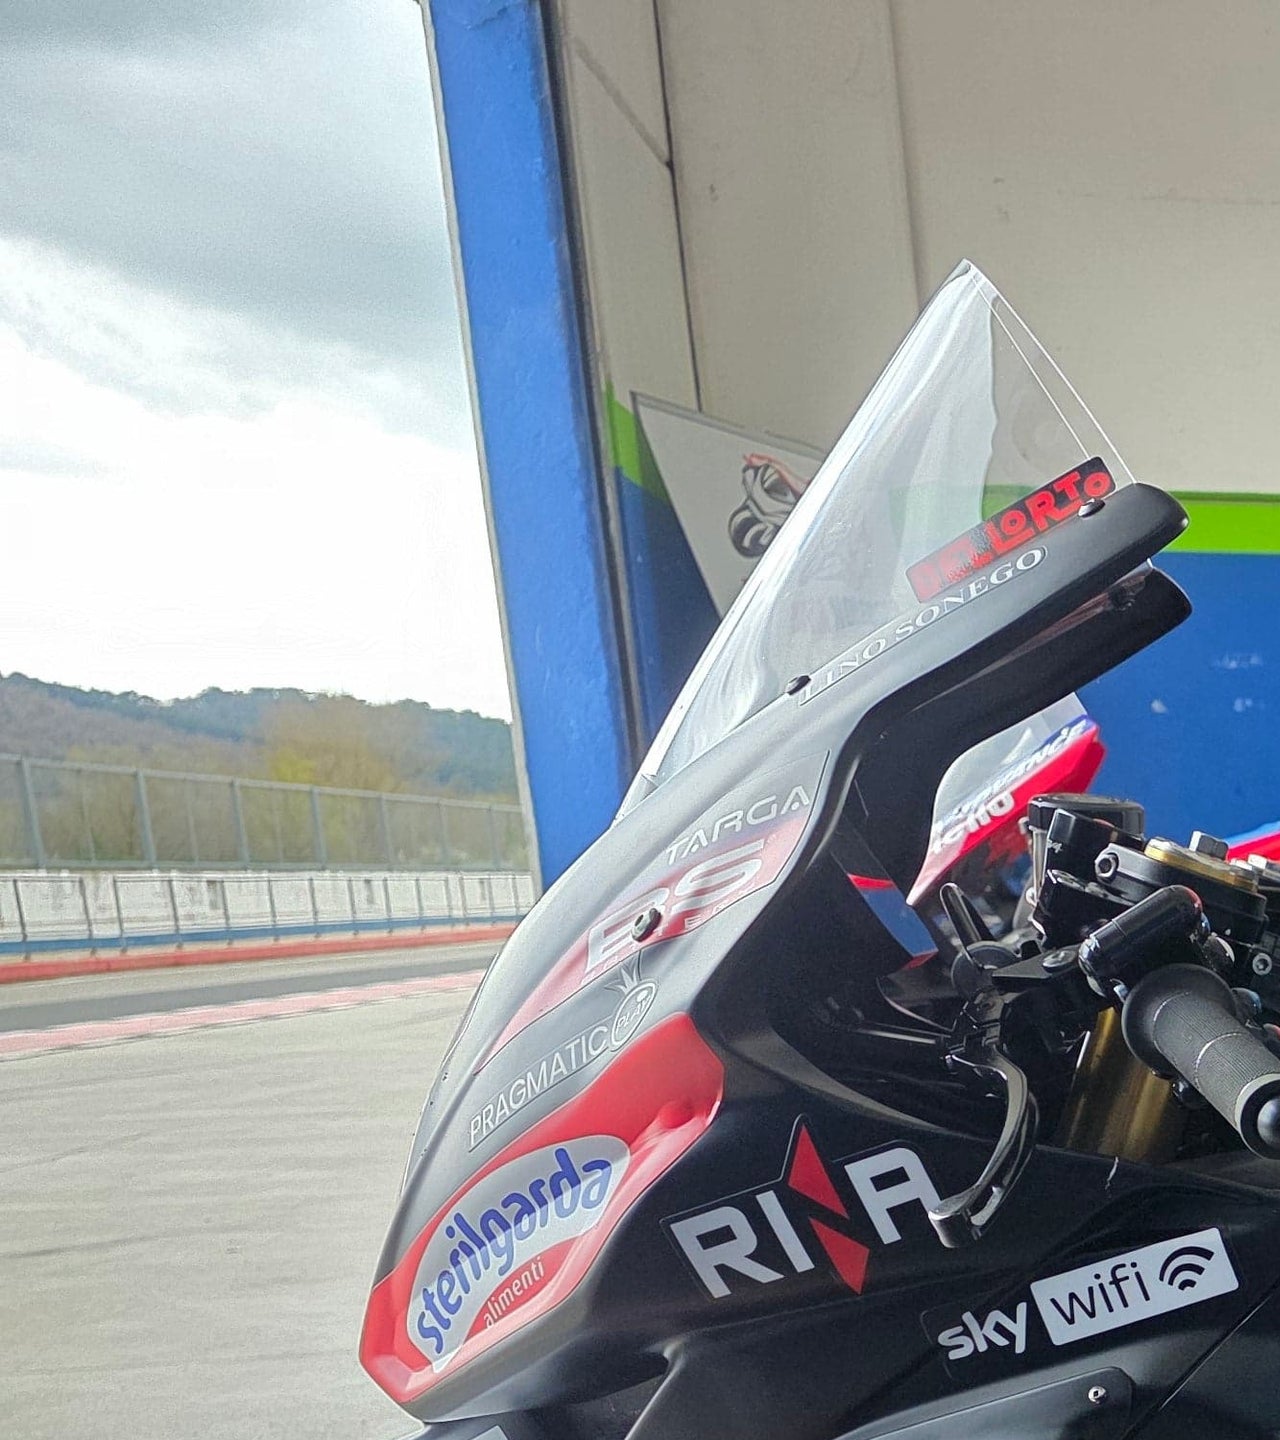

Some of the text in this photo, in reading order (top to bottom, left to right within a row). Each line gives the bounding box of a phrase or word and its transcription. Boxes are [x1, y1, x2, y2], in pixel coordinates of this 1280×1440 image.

[895, 546, 1045, 641] SONEGO
[666, 785, 811, 865] TARGA
[468, 1024, 610, 1148] PRAGMATIC
[417, 1146, 613, 1354] sterilgarda
[670, 1123, 943, 1298] RINA
[483, 1256, 545, 1329] alimenti
[937, 1261, 1152, 1361] sky wifi
